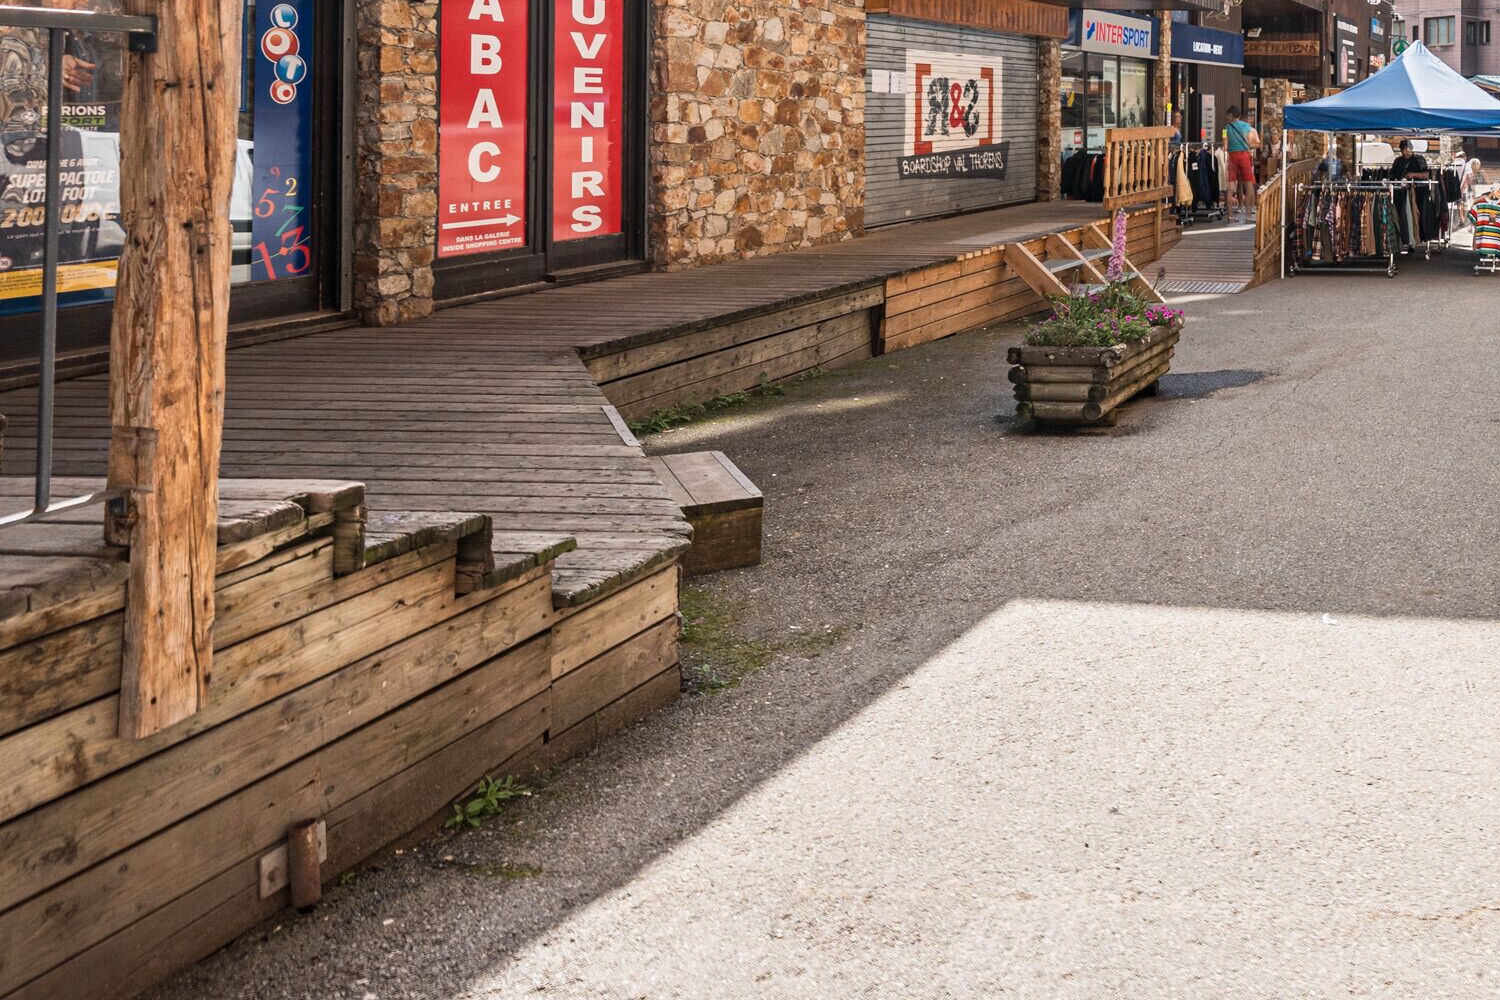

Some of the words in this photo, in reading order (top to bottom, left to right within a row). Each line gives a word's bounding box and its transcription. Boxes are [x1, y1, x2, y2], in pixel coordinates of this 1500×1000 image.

[1095, 21, 1150, 48] INTERSPORT
[265, 6, 302, 102] LOTO
[41, 105, 106, 116] PRIONS
[902, 155, 951, 175] BOARDSHOP
[953, 154, 968, 172] VAL
[969, 151, 1003, 171] THORENS
[8, 172, 46, 189] SUPE
[285, 177, 298, 197] 2
[22, 189, 46, 204] LOT
[255, 188, 279, 218] 5
[449, 199, 512, 214] ENTREE
[274, 204, 304, 237] 7
[442, 244, 465, 252] INSIDE
[465, 240, 497, 249] SHOPPING
[498, 236, 523, 245] CENTRE
[456, 235, 474, 243] DANS
[474, 233, 484, 241] LA
[484, 230, 511, 239] GALERIE
